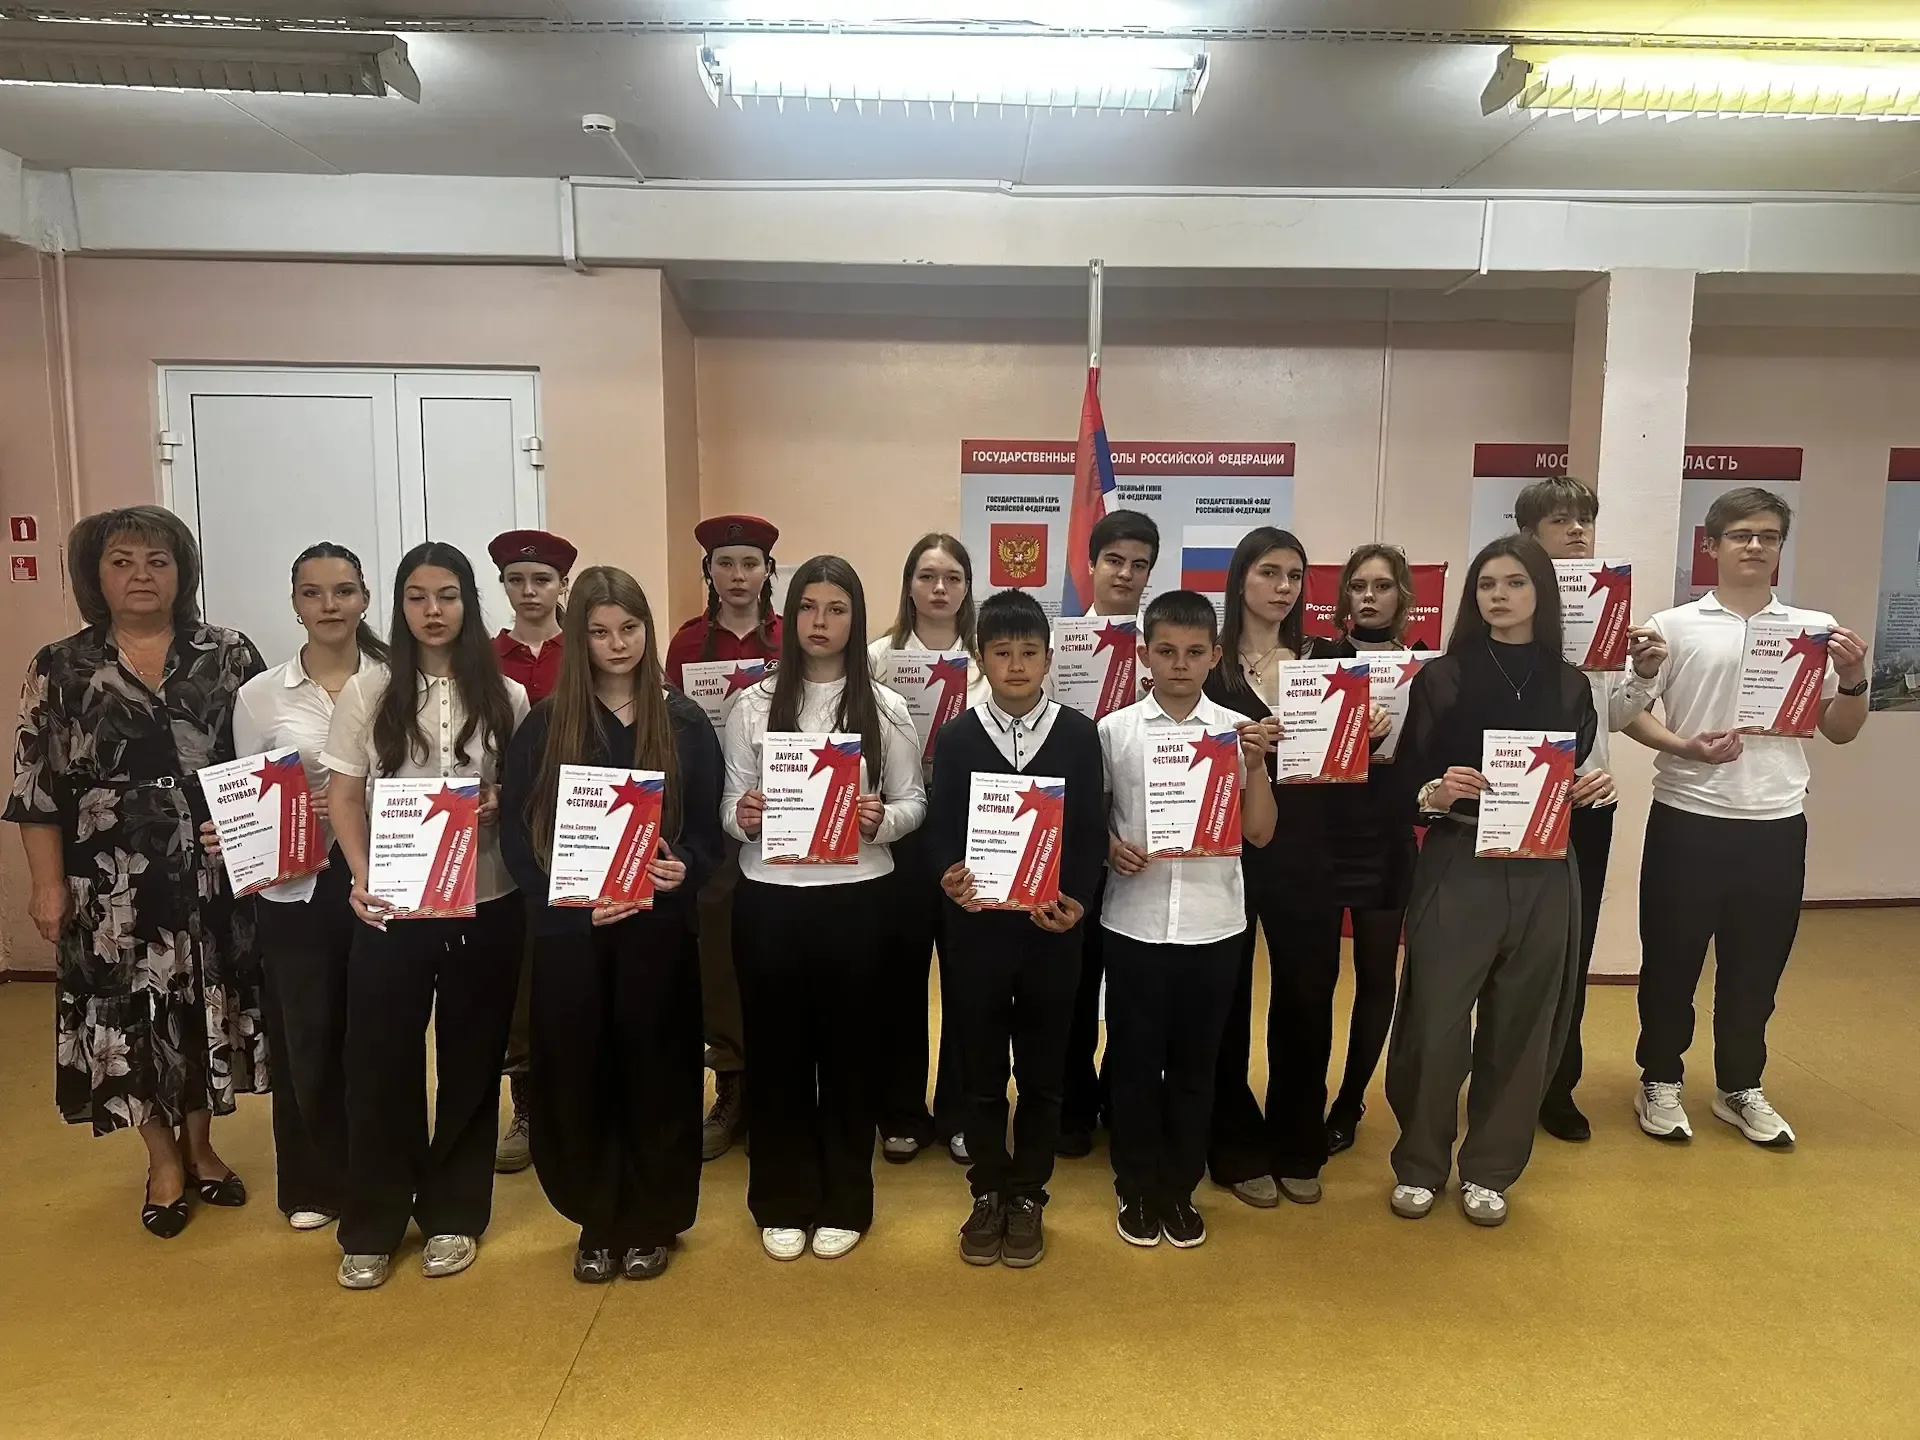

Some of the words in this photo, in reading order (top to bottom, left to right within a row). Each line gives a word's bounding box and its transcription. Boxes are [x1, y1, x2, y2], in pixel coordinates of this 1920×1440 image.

[973, 451, 1076, 463] ГОСУДАРСТВЕННЫЕ
[1141, 452, 1213, 464] РОССИЙСКОЙ
[1218, 454, 1285, 466] ФЕДЕРАЦИИ
[1683, 455, 1738, 470] ЛАСТЬ
[1127, 493, 1162, 501] ФЕДЕРАЦИИ
[1061, 644, 1092, 652] ФЕСТИВАЛЯ
[1291, 678, 1317, 686] ЛАУРЕАТ
[692, 688, 723, 696] ФЕСТИВАЛЯ
[1286, 689, 1322, 697] ФЕСТИВАЛЯ
[1157, 744, 1184, 753] ЛАУРЕАТ
[775, 752, 803, 760] ЛАУРЕАТ
[1152, 756, 1189, 764] ФЕСТИВАЛЯ
[770, 764, 808, 772] ФЕСТИВАЛЯ
[219, 778, 248, 792] ЛАУРЕАТ
[572, 786, 603, 796] ЛАУРЕАТ
[217, 788, 258, 804] ФЕСТИВАЛЯ
[983, 793, 1010, 802] ЛАУРЕАТ
[387, 798, 418, 806] ЛАУРЕАТ
[566, 799, 608, 808] ФЕСТИВАЛЯ
[977, 805, 1014, 814] ФЕСТИВАЛЯ
[381, 810, 422, 818] ФЕСТИВАЛЯ
